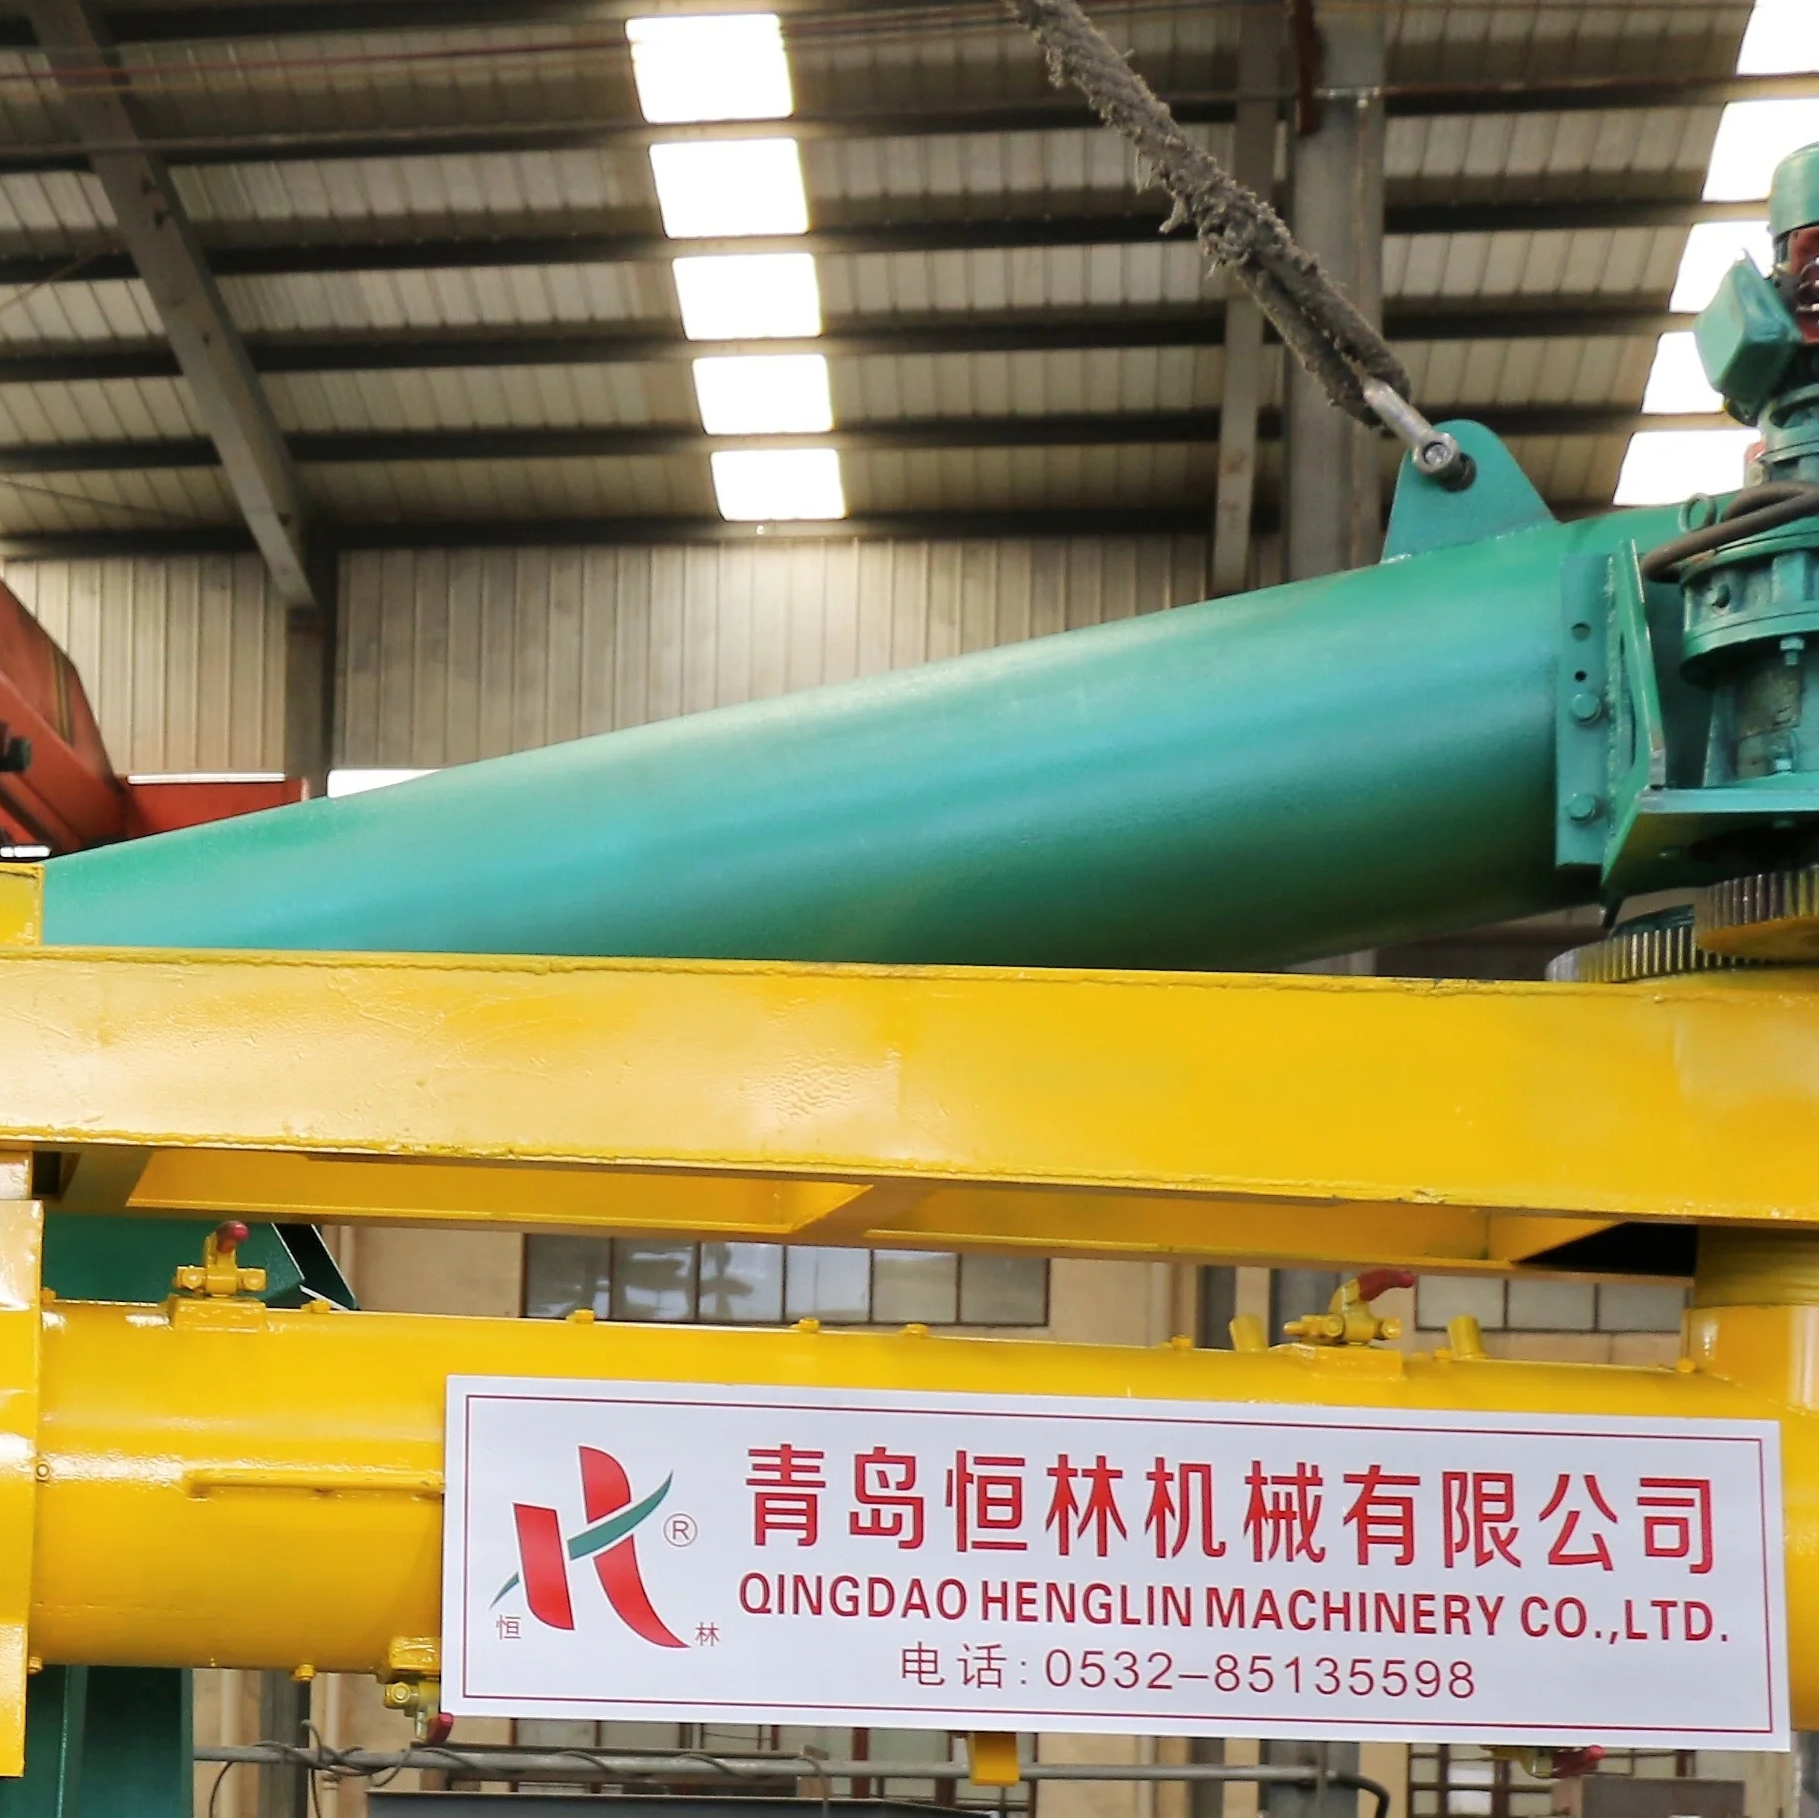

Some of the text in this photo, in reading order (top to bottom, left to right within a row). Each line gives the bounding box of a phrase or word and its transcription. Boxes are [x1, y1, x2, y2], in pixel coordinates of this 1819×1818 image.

[745, 1443, 1716, 1576] 青岛恒林机械有限公司
[495, 1614, 721, 1647] 恒 林
[738, 1572, 1729, 1645] QINGDAO HENGLIN MACHINERY CO.,LTD.
